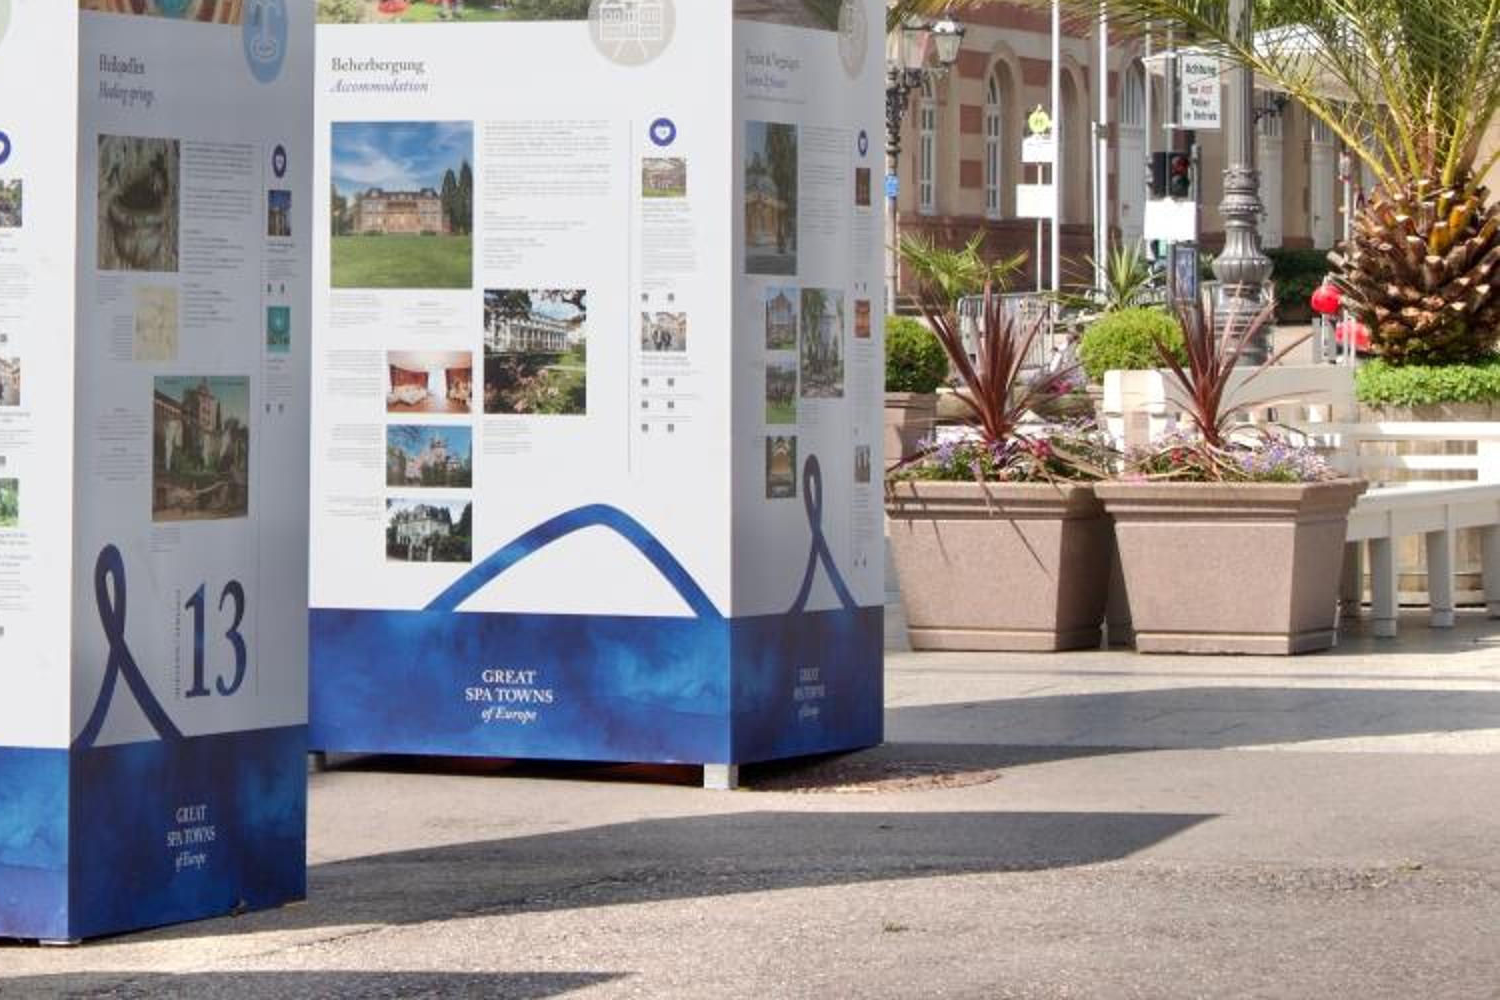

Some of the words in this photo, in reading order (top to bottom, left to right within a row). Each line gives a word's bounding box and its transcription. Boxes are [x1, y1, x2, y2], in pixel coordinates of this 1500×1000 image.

[331, 57, 426, 75] Beherbergung
[185, 579, 247, 699] 13
[481, 669, 537, 685] GREAT
[464, 687, 492, 702] SPA
[495, 688, 554, 705] TOWNS
[481, 706, 494, 724] of
[494, 706, 538, 725] Europe
[176, 804, 208, 823] GREAT
